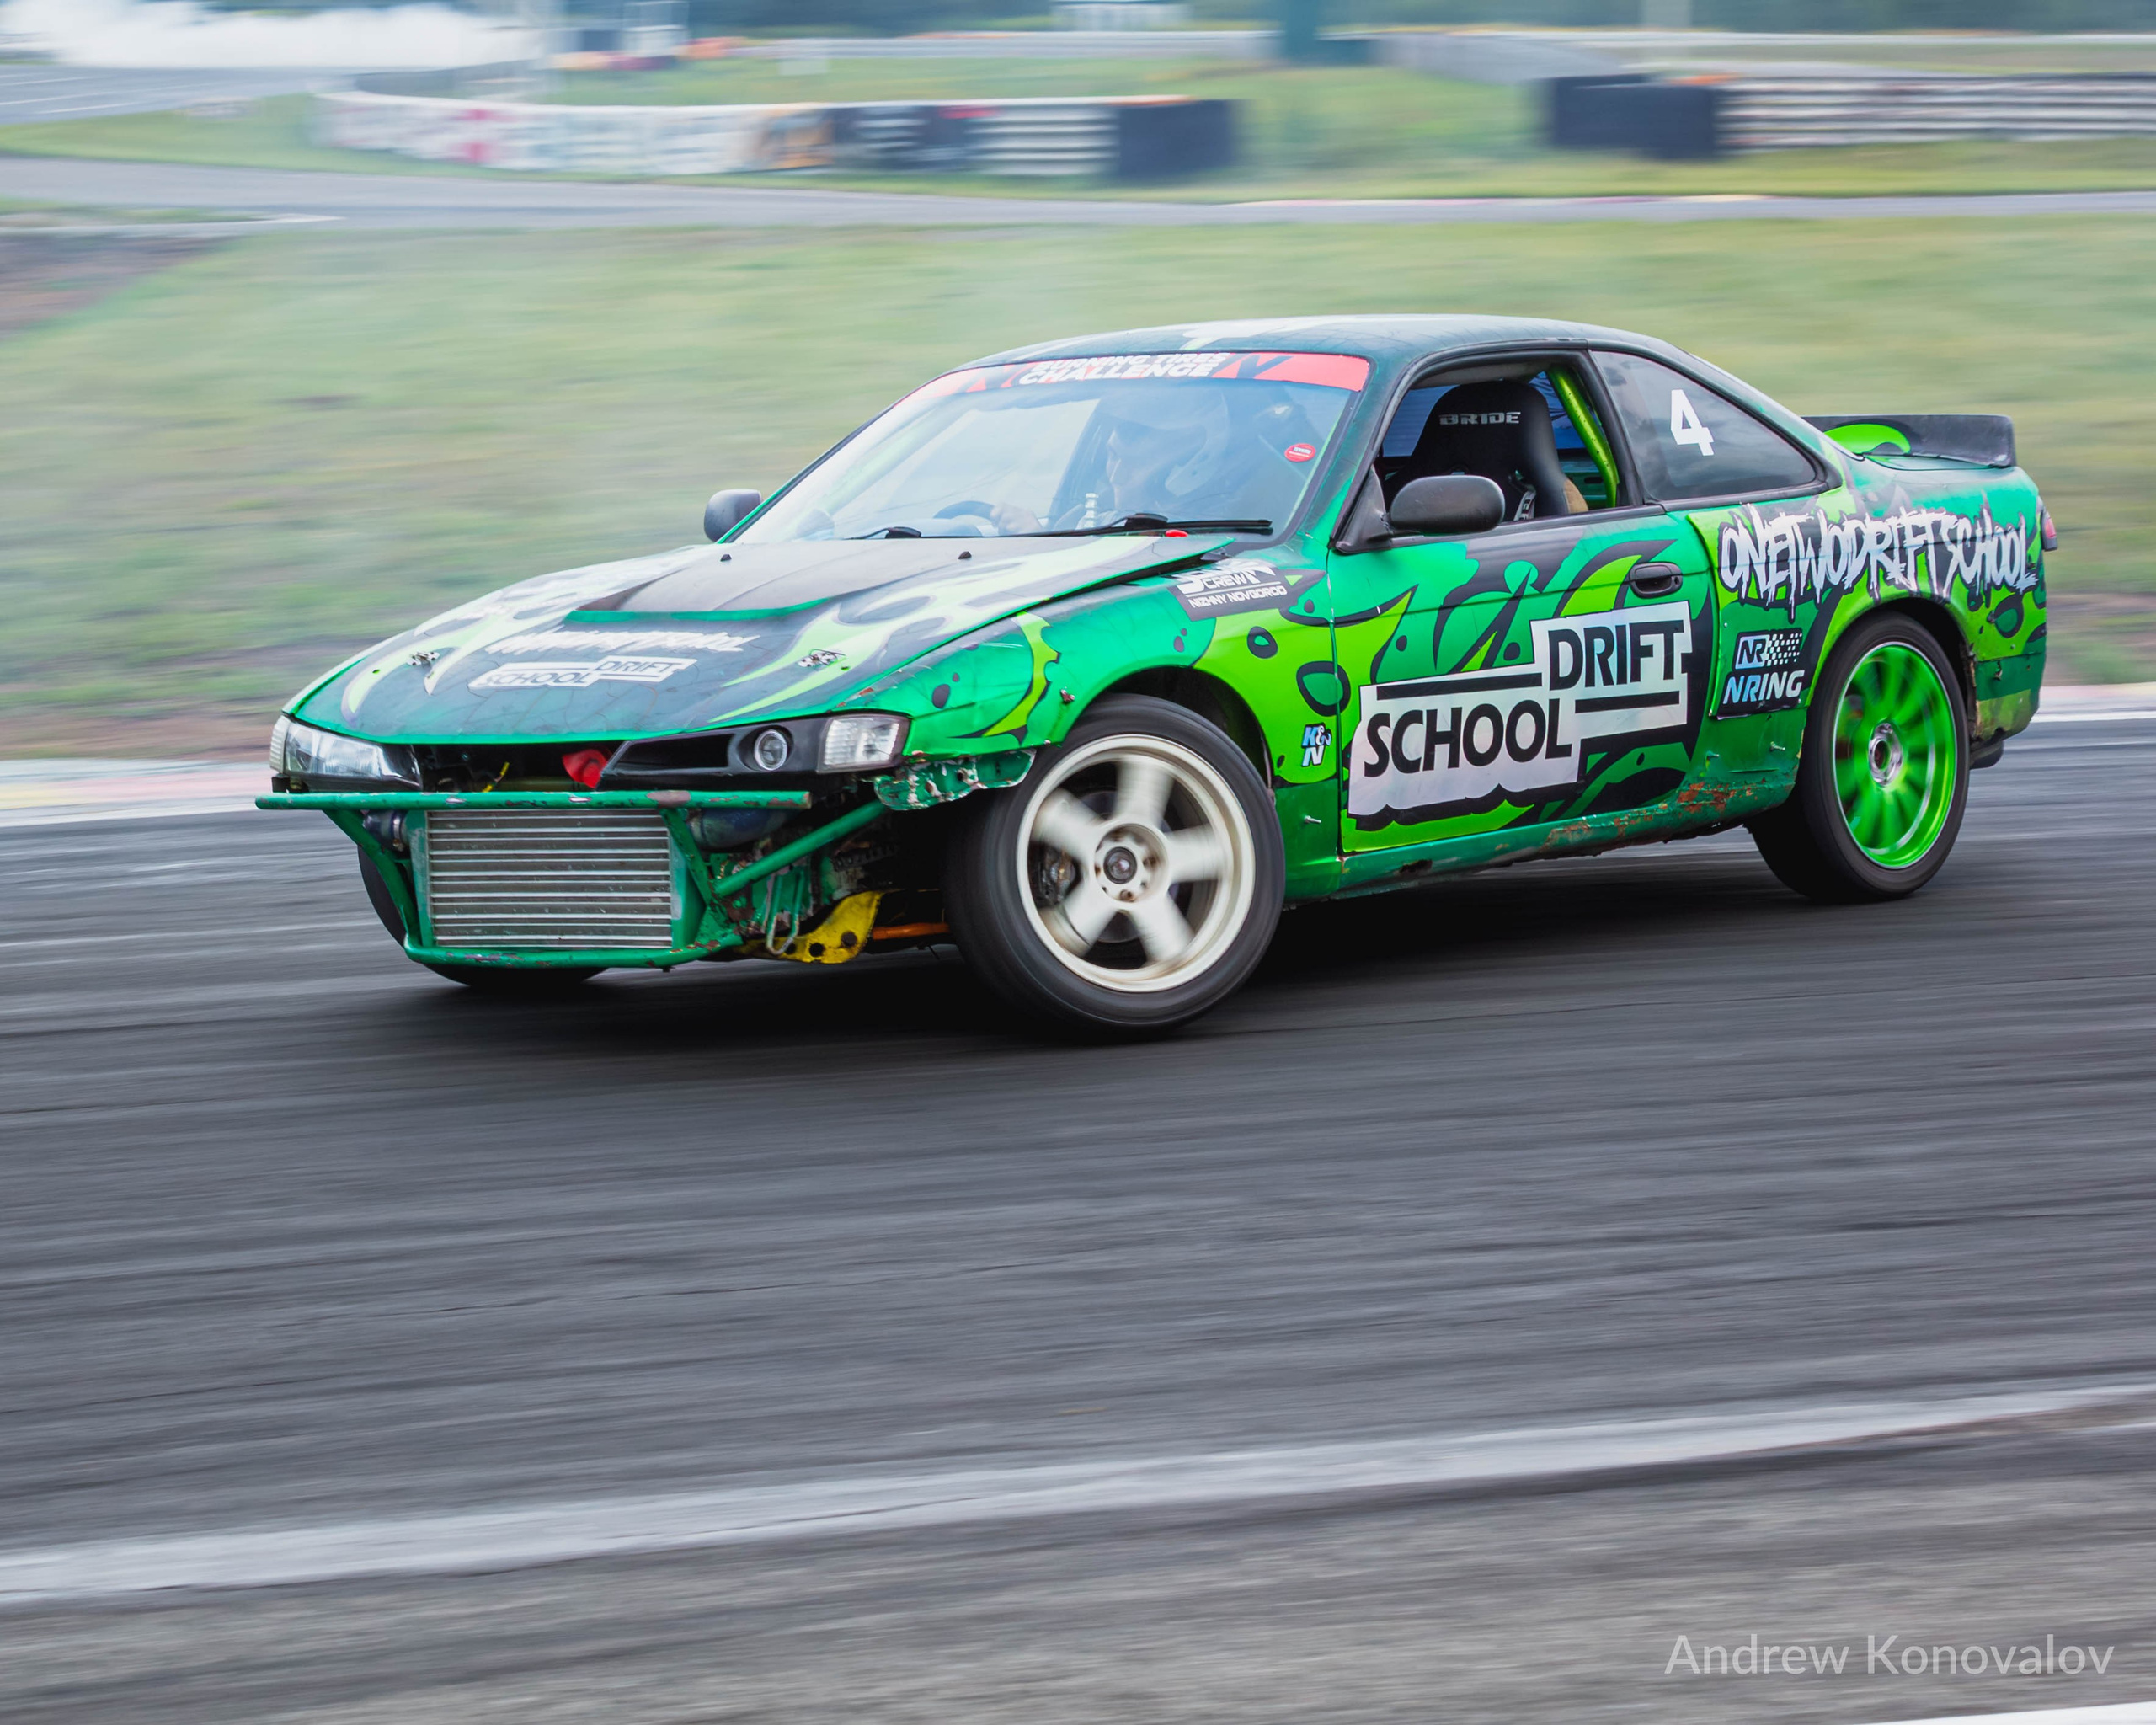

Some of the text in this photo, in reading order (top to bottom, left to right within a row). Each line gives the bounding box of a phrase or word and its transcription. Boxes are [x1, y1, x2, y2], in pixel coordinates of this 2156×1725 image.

[1155, 352, 1231, 364] TIRES
[1018, 363, 1220, 385] CHALLENGE
[1438, 411, 1521, 425] BRIDE
[1670, 389, 1715, 456] 4
[1202, 572, 1248, 589] CREW
[1187, 585, 1288, 608] NIZHNY NOVGOROD
[596, 660, 684, 673] DRIFT
[1548, 620, 1684, 691] DRIFT
[478, 672, 592, 685] SCHOOL
[1722, 670, 1805, 704] NRING
[1364, 698, 1572, 778] SCHOOL
